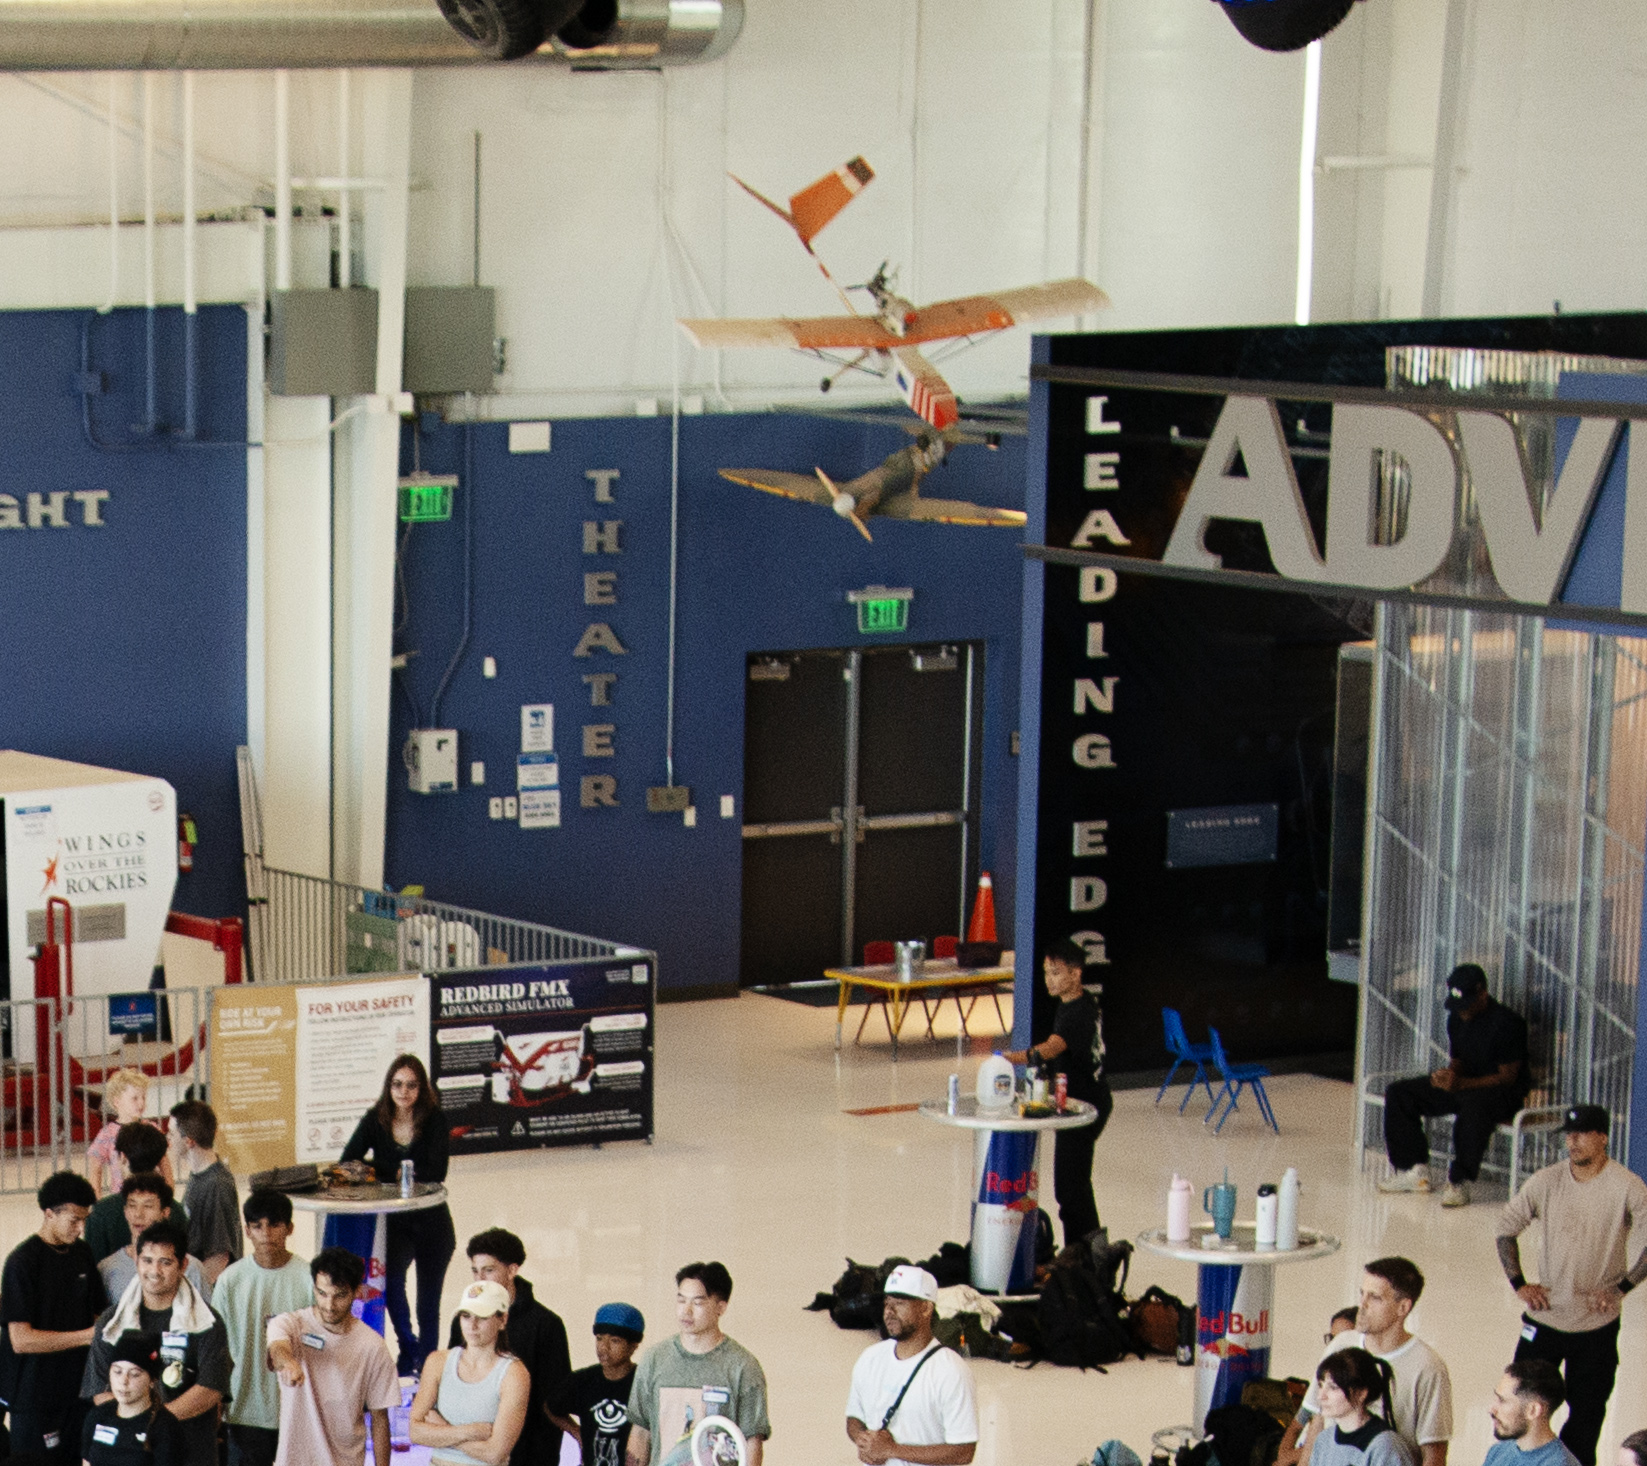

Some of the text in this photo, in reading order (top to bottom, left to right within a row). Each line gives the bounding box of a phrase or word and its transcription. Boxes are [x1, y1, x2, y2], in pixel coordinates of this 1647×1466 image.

[572, 468, 630, 809] THEATER
[1069, 396, 1131, 995] LEADING EDG
[64, 830, 147, 852] WINGS
[63, 854, 147, 873] OVER THE
[65, 872, 148, 896] ROCKIES
[439, 978, 571, 1005] REDBIRD FMX
[307, 994, 416, 1016] FOR YOUR SAFETY
[439, 996, 576, 1018] ADVANCED SIMULATOR
[986, 1169, 1027, 1193] Red
[1228, 1308, 1270, 1334] Bull
